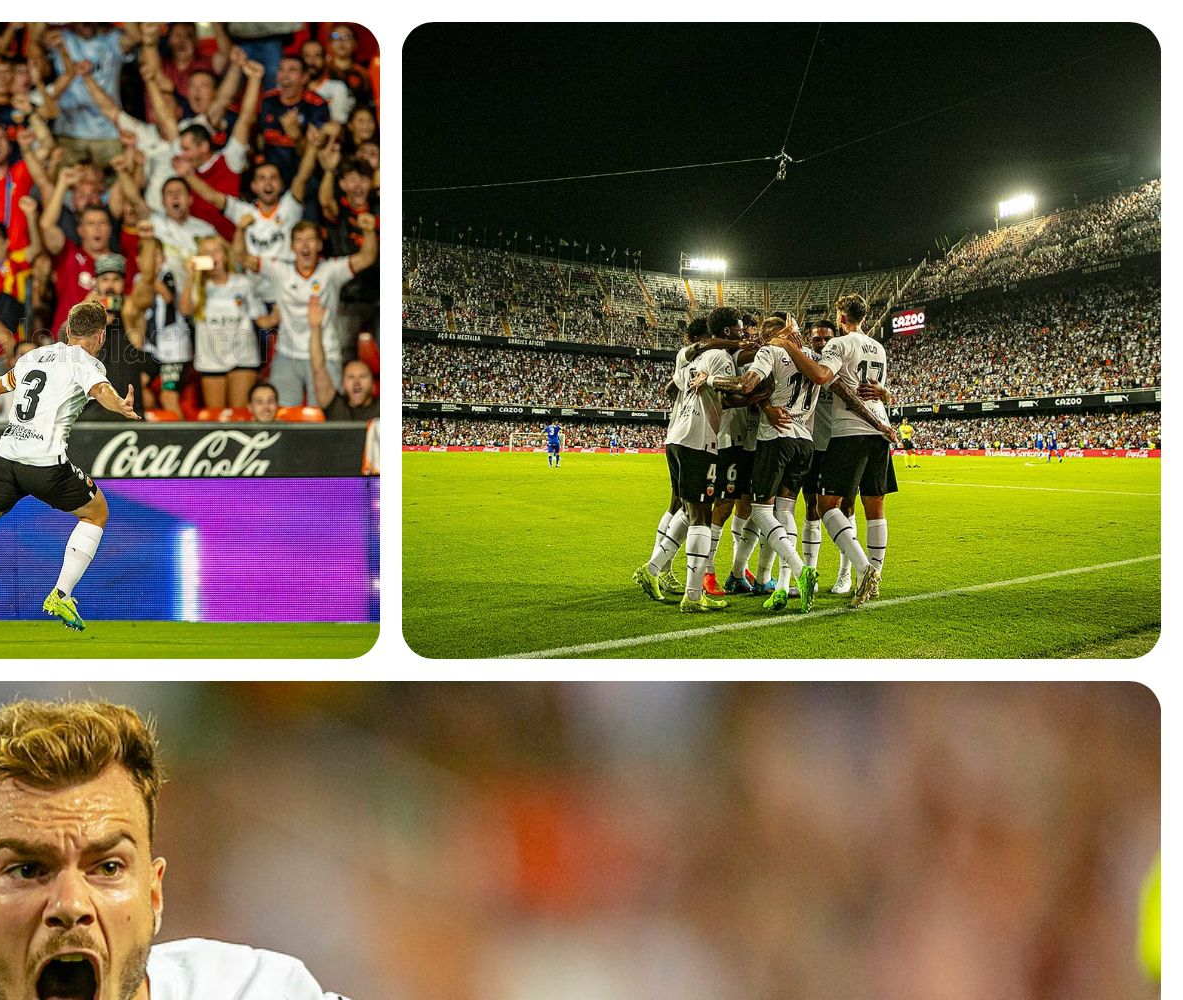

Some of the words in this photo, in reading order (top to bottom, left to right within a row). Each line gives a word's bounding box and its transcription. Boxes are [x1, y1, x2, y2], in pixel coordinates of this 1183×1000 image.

[892, 312, 925, 329] CAZOO
[861, 345, 878, 355] NICO
[15, 369, 48, 424] 3
[1055, 397, 1083, 406] CAZOO
[706, 463, 717, 483] 4
[726, 463, 737, 481] 6
